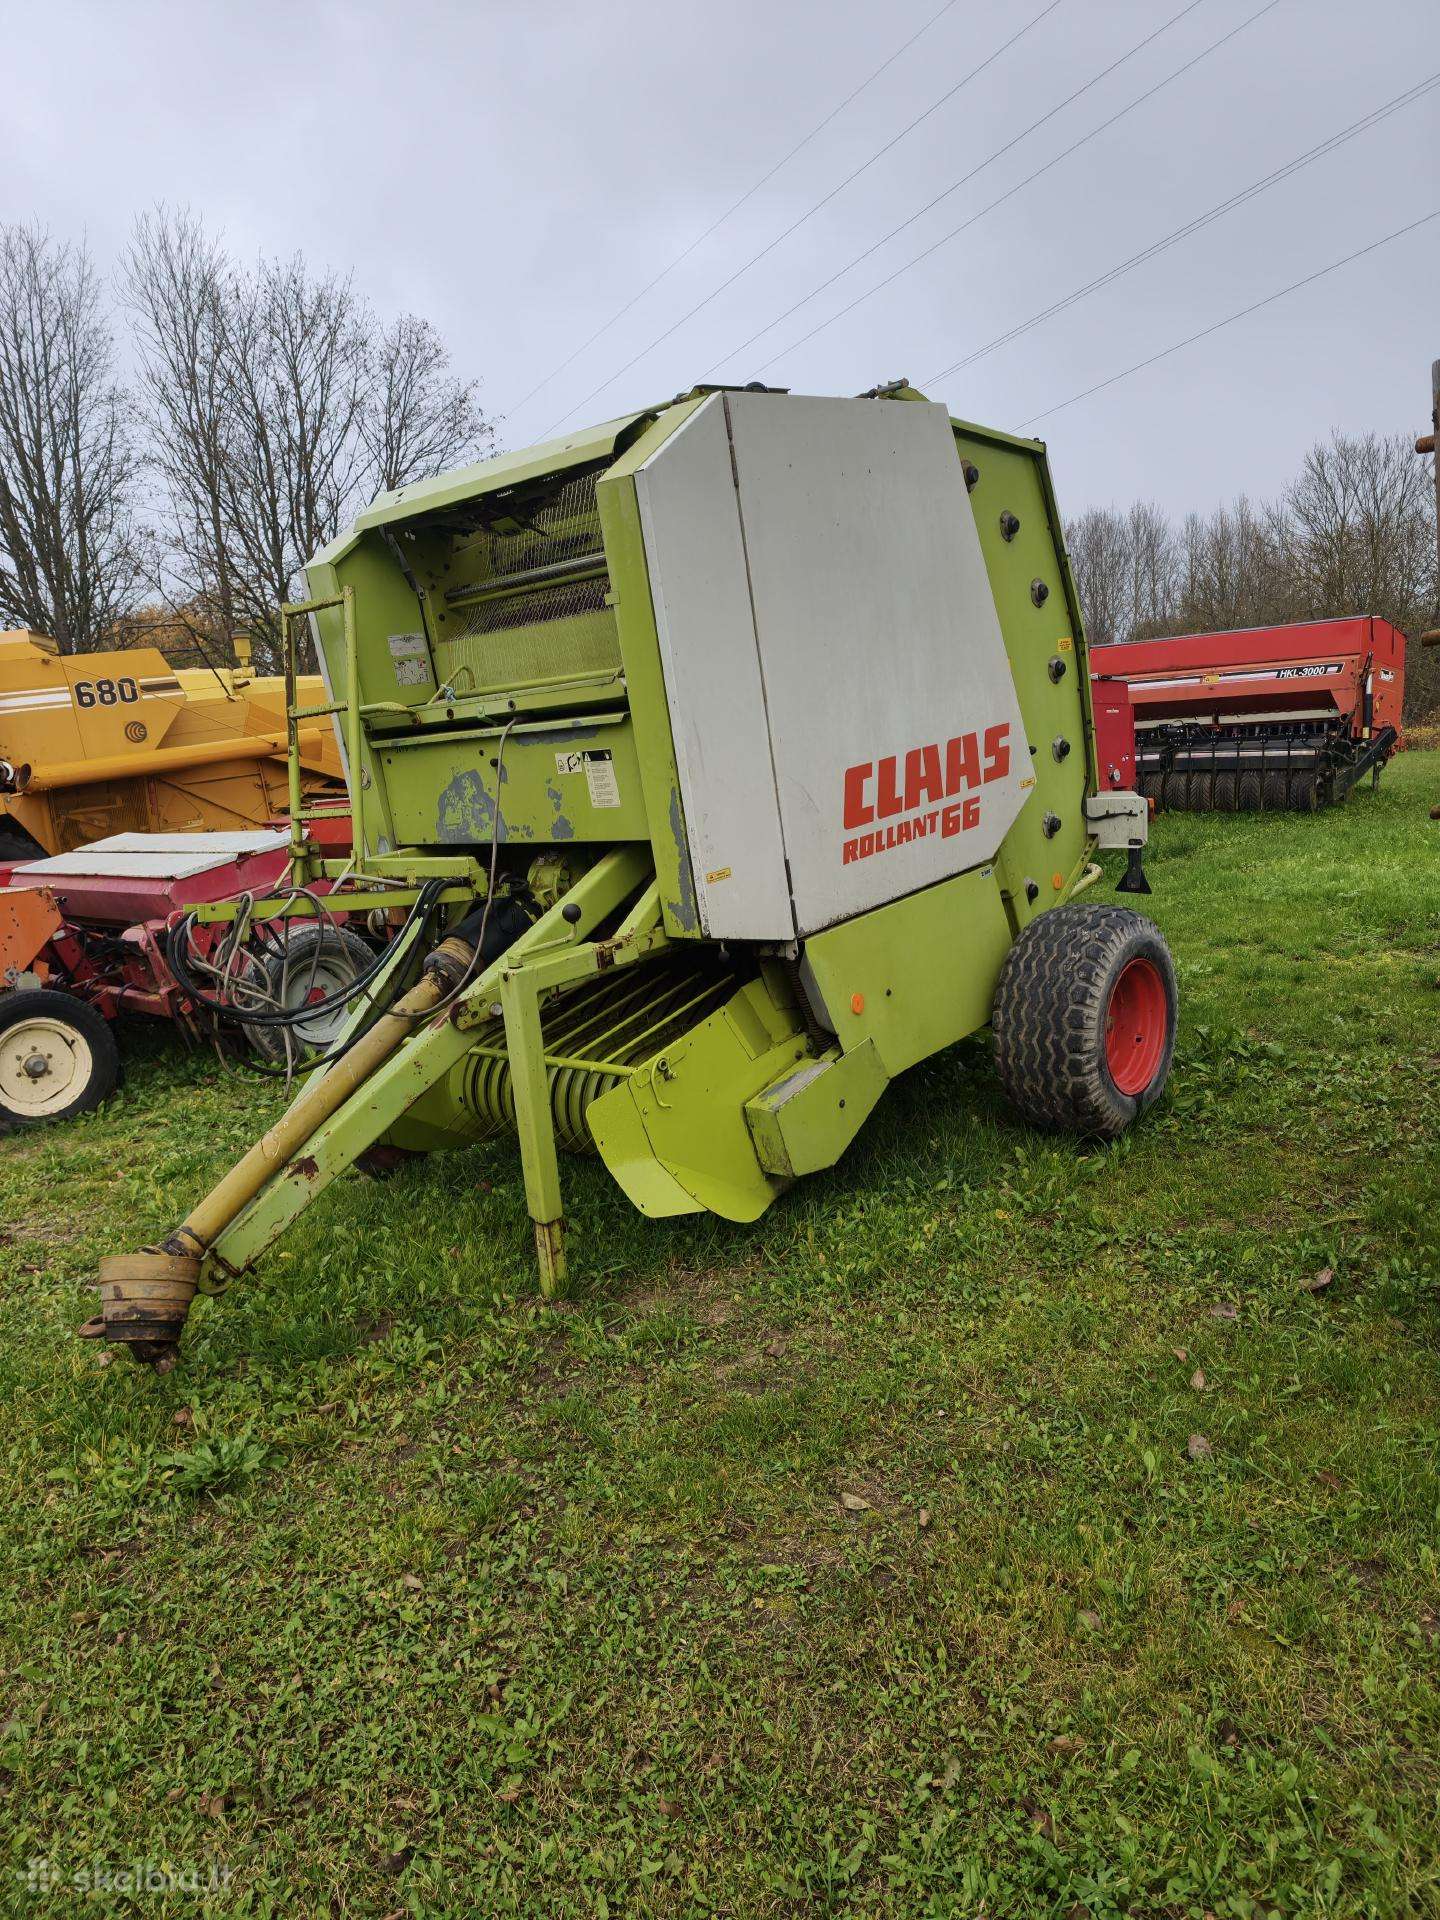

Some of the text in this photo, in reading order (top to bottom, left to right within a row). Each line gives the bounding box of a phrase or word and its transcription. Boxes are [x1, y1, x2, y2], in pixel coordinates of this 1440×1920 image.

[1280, 666, 1326, 678] HKL-3000
[74, 677, 139, 708] 680
[843, 722, 1010, 831] CLAAS
